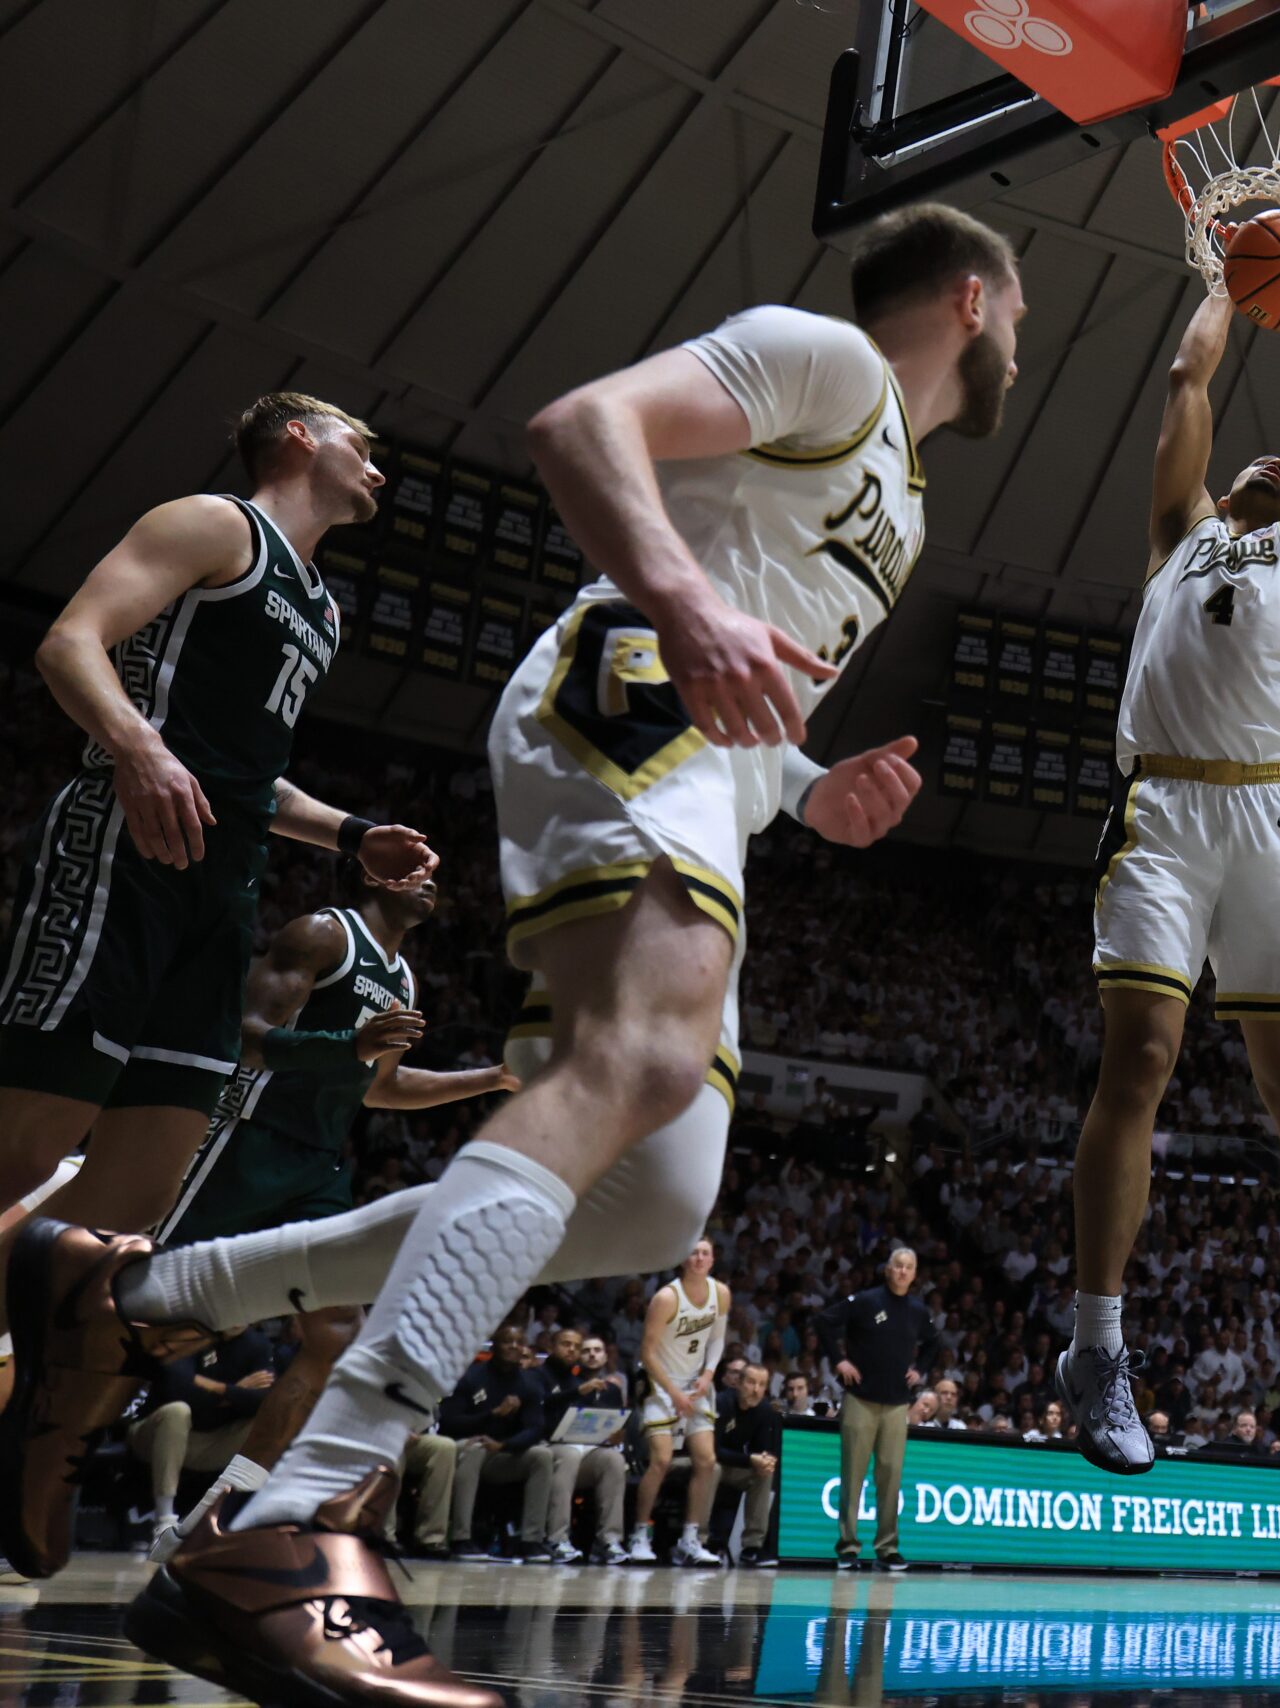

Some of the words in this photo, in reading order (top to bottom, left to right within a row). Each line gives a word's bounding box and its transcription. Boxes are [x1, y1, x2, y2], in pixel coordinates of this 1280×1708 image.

[264, 590, 333, 674] SPARTANS
[1203, 585, 1235, 626] 4
[264, 643, 318, 729] 15
[688, 1339, 699, 1354] 2
[915, 1483, 1102, 1532] DOMINION
[1112, 1496, 1243, 1538] FREIGHT
